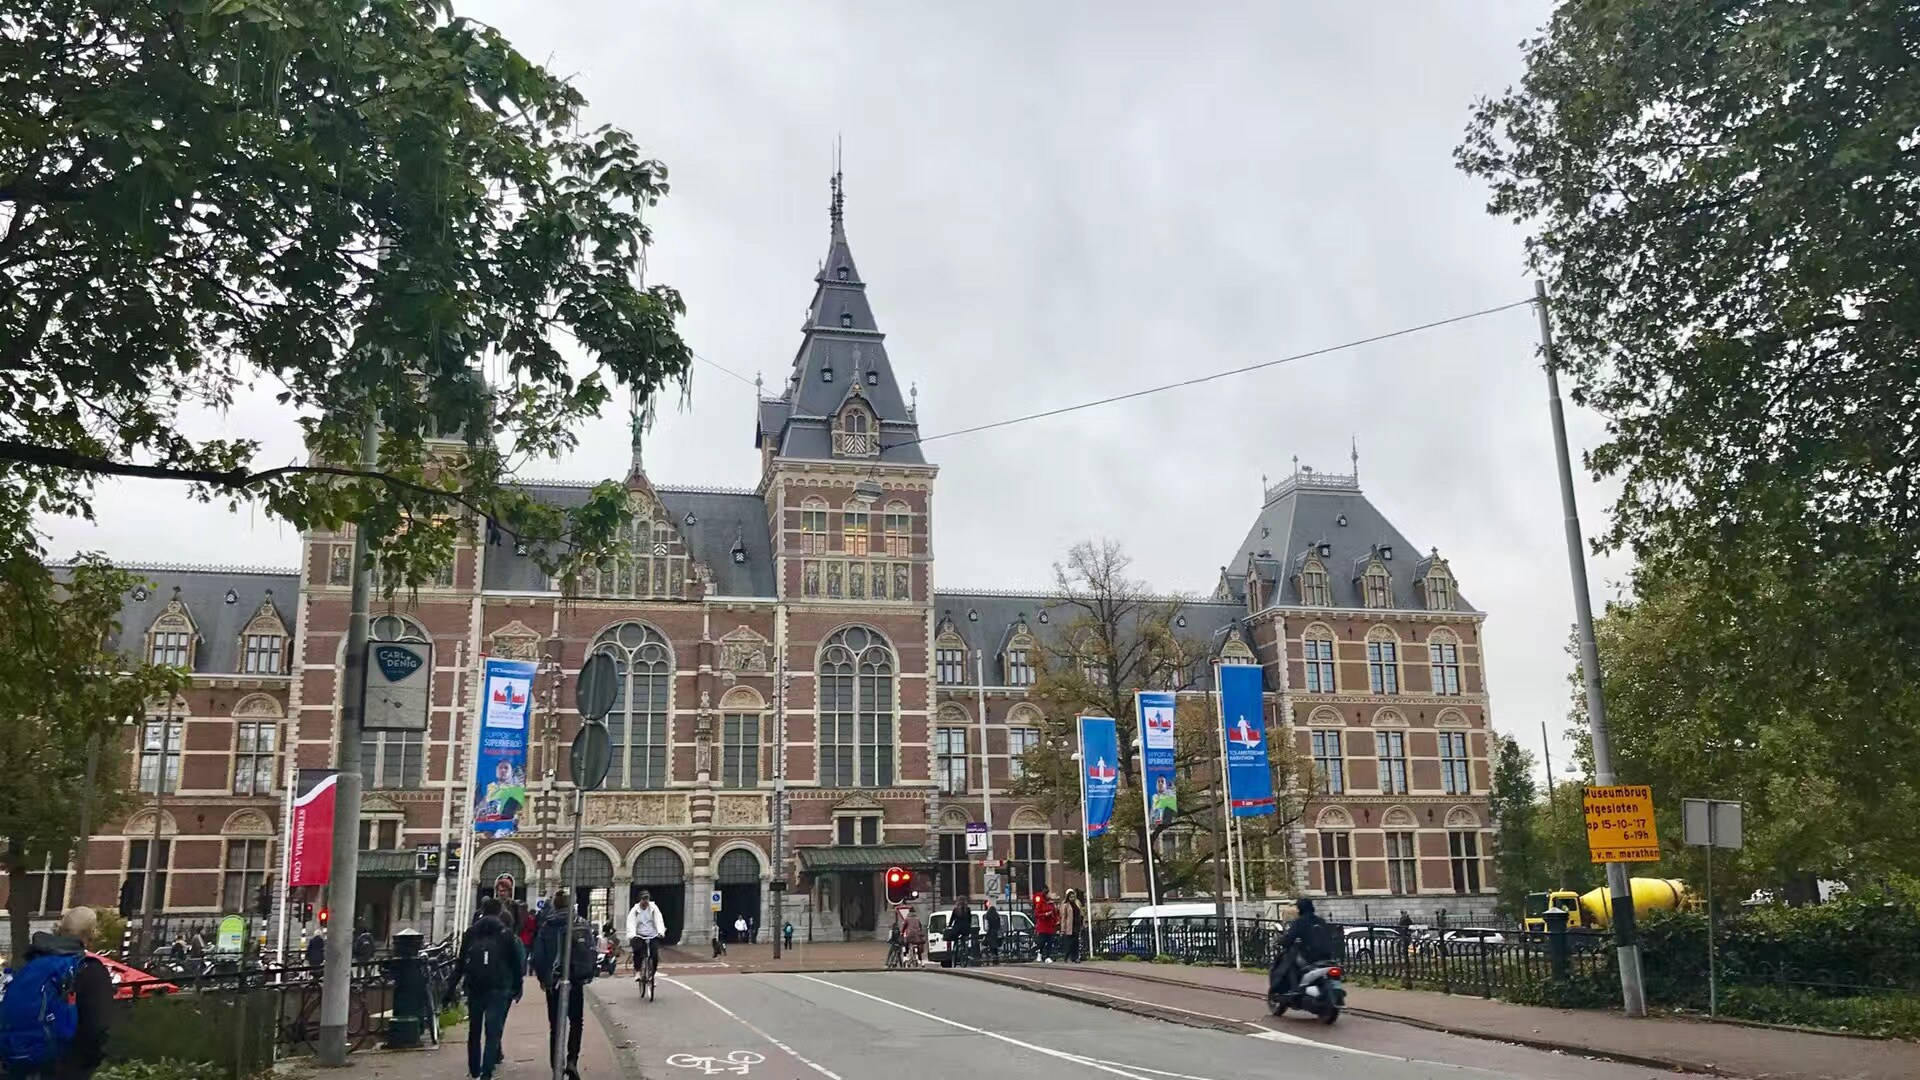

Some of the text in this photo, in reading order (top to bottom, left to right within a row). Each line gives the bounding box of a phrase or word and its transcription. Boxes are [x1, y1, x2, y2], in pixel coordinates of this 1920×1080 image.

[380, 650, 406, 659] CARL
[387, 659, 417, 668] DENIG
[1585, 804, 1638, 816] afgesloten
[1587, 822, 1599, 831] op
[1624, 830, 1648, 840] 6-19h
[1620, 849, 1660, 858] marathon
